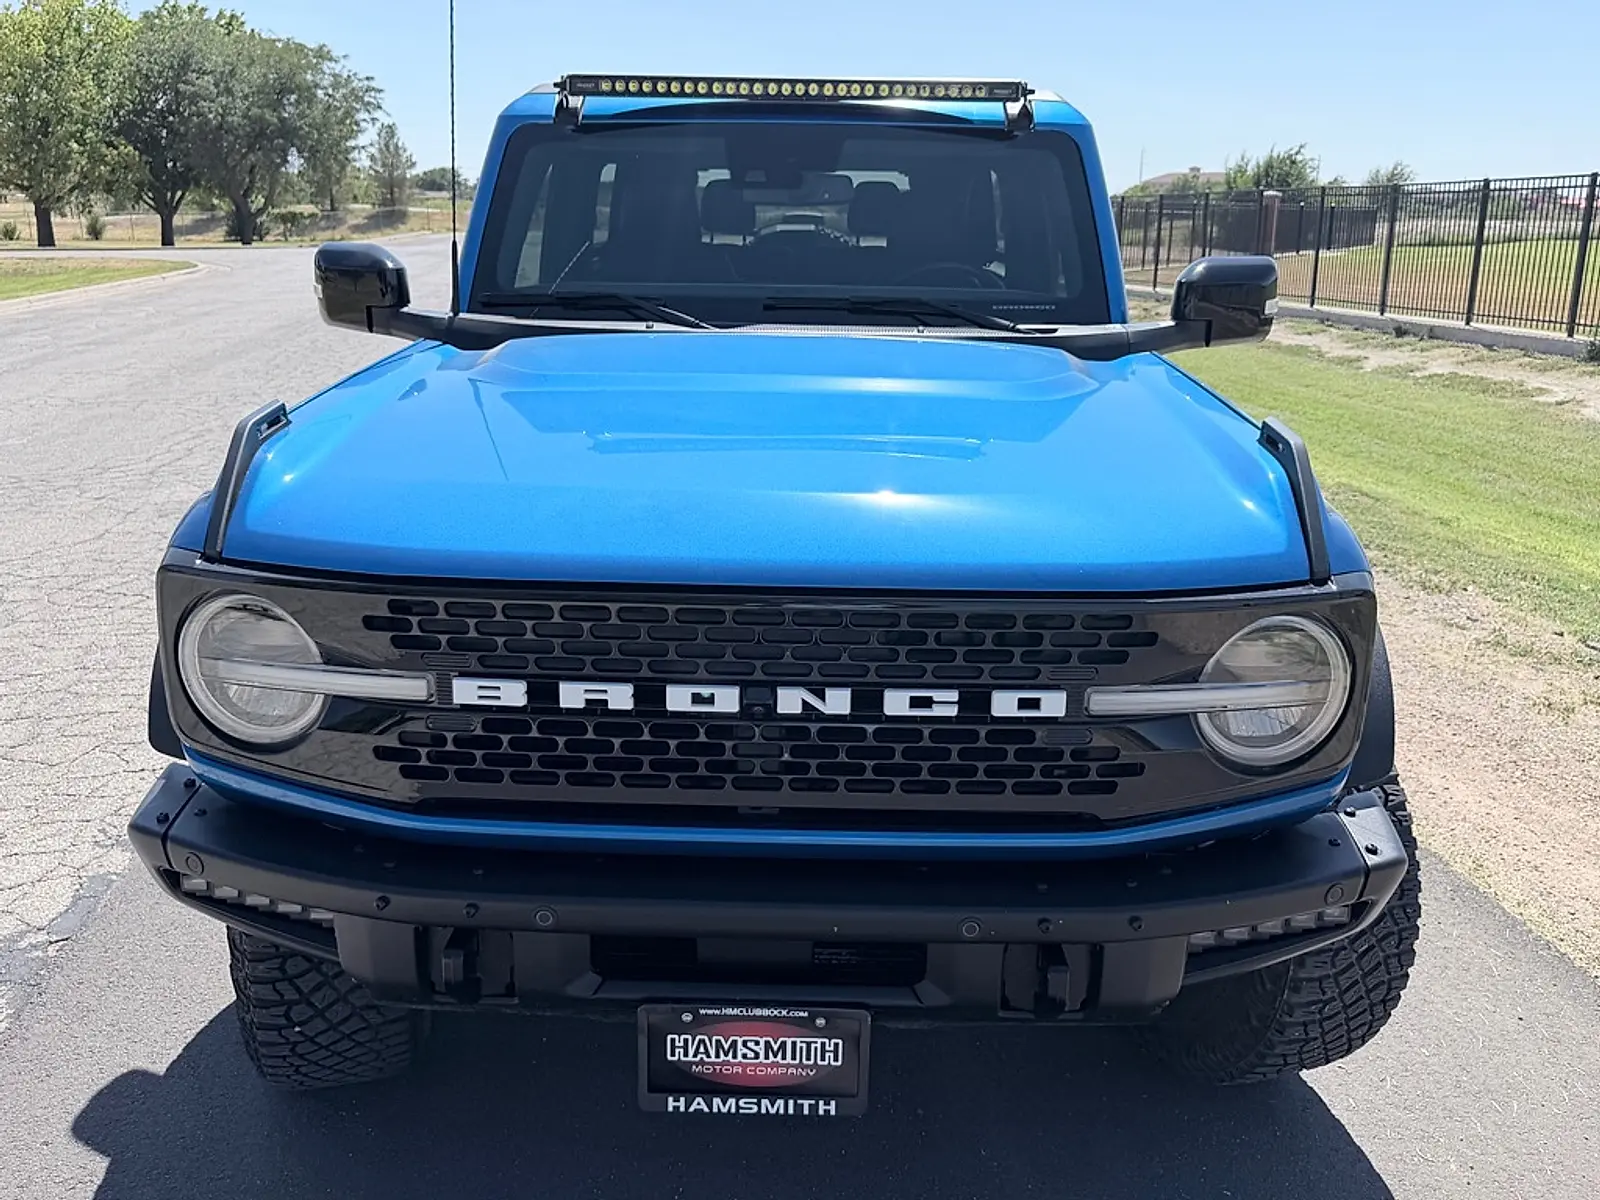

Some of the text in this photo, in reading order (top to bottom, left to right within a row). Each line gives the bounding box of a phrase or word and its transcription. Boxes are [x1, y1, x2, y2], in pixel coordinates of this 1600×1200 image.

[452, 676, 1067, 717] BRONCO
[666, 1034, 843, 1066] HAMSMITH
[691, 1065, 817, 1077] MOTOR COMPANY
[666, 1096, 836, 1116] HAMSMITH
